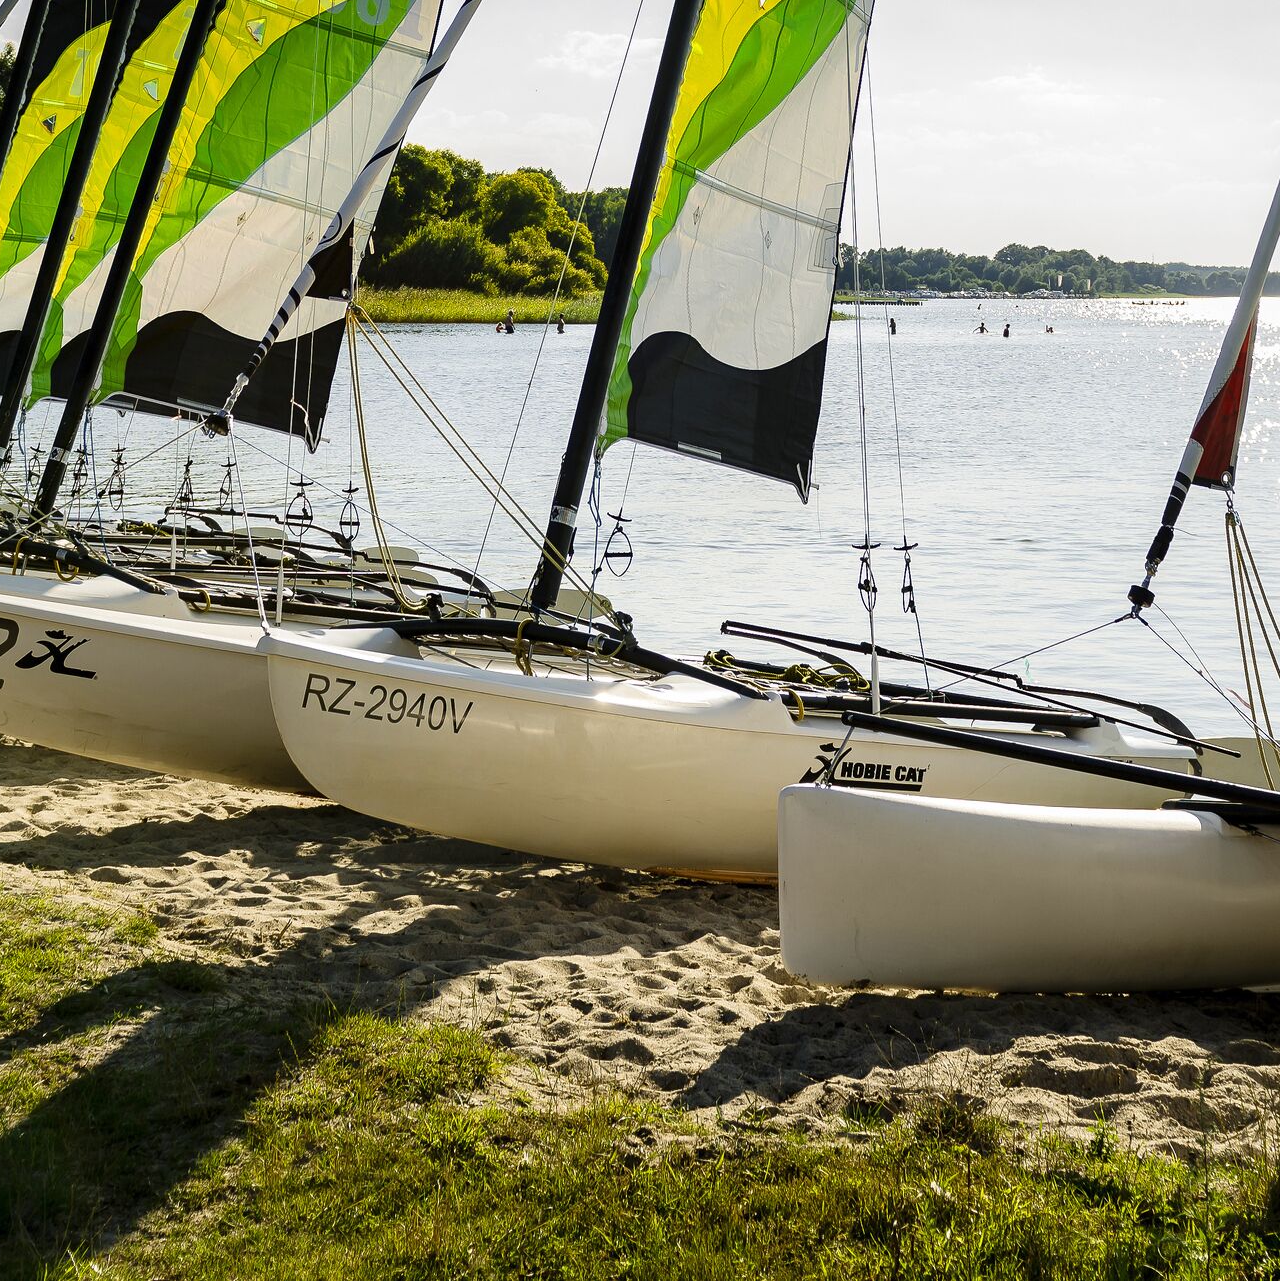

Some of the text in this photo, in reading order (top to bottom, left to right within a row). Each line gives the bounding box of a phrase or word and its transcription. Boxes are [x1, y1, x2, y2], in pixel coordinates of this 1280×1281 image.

[301, 673, 473, 734] RZ-2940V
[840, 761, 927, 783] HOBIE CAT
